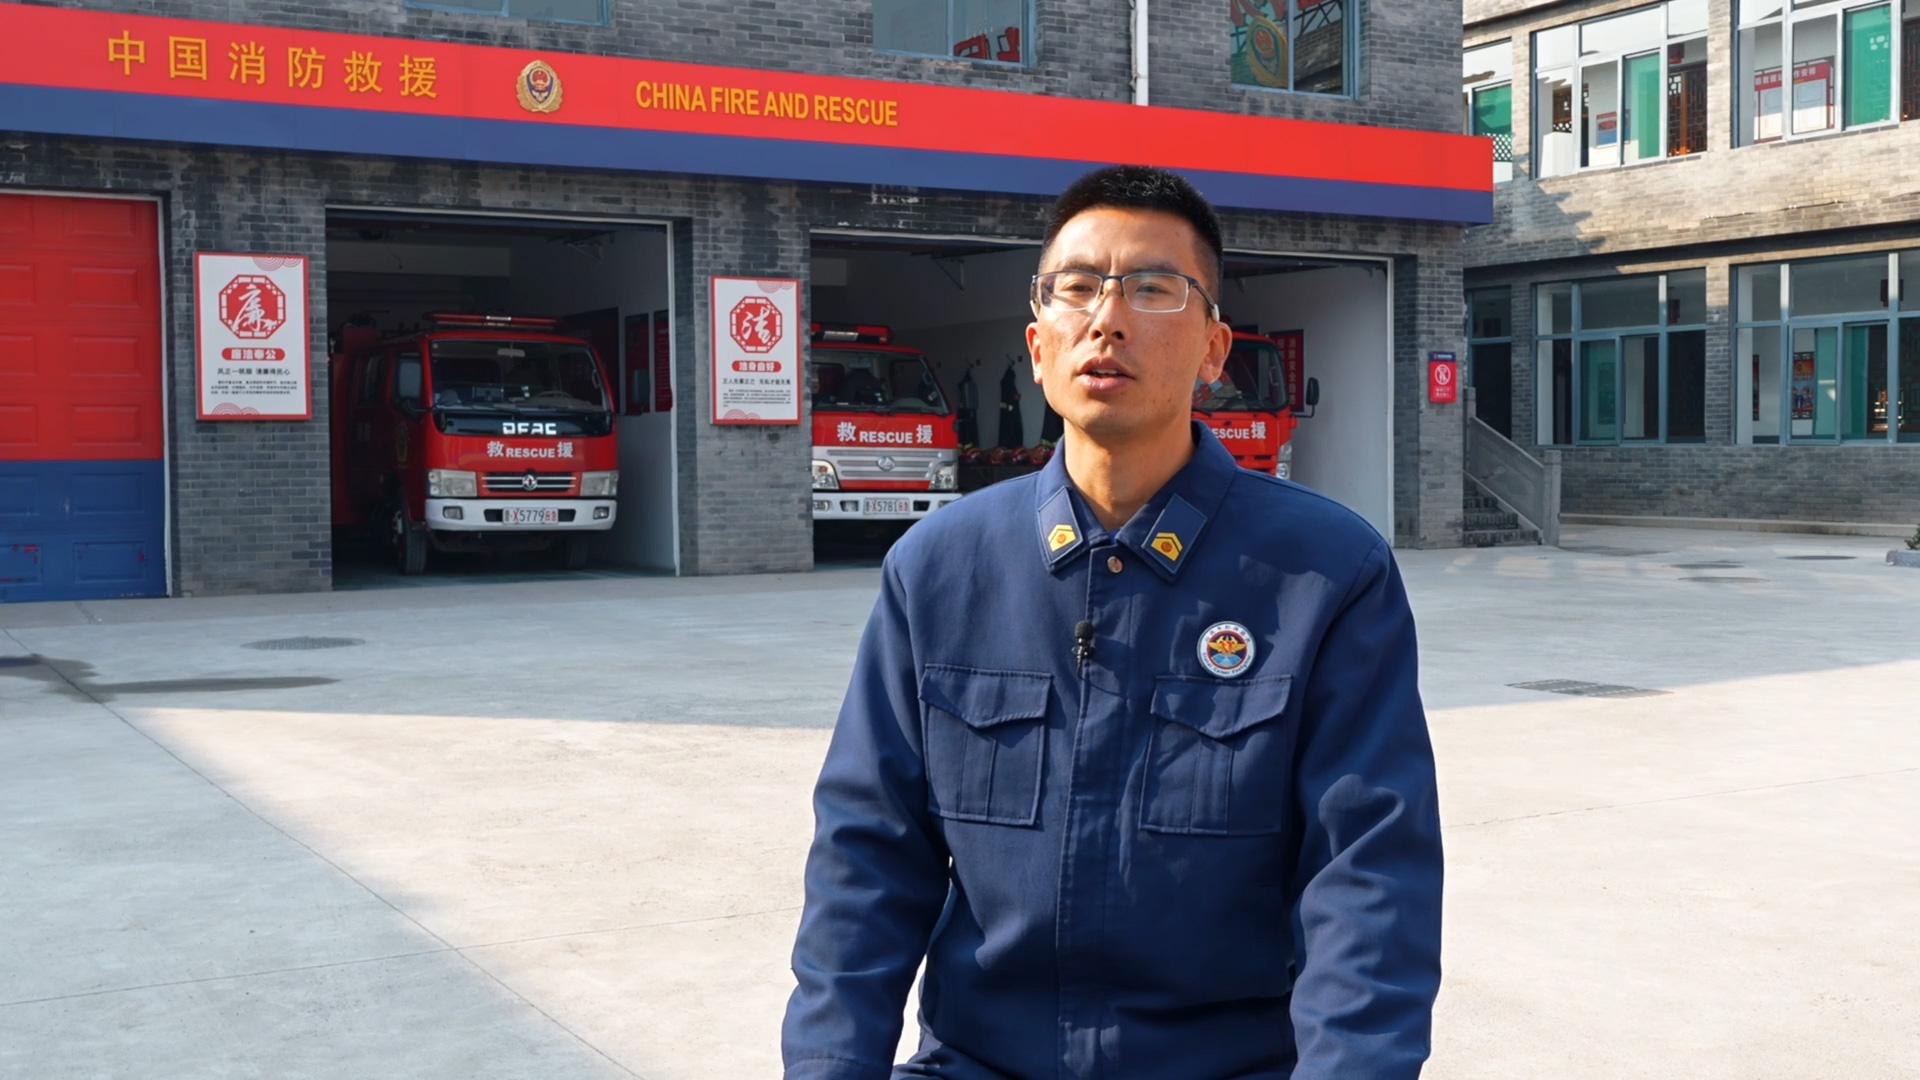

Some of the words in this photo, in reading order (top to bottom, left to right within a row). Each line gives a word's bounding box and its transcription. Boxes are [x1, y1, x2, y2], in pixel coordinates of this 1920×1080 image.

[107, 29, 439, 99] 中国消防救援
[635, 80, 707, 113] CHINA
[711, 86, 760, 116] FIRE
[763, 91, 809, 119] AND
[814, 95, 899, 127] RESCUE
[232, 283, 274, 331] 廉
[502, 422, 557, 435] DFAC
[837, 421, 857, 442] 救
[859, 431, 913, 444] RESCUE
[916, 424, 933, 444] 援
[1251, 421, 1266, 439] 援
[486, 441, 504, 458] 救
[506, 448, 556, 458] RESCUE
[557, 441, 574, 458] 援
